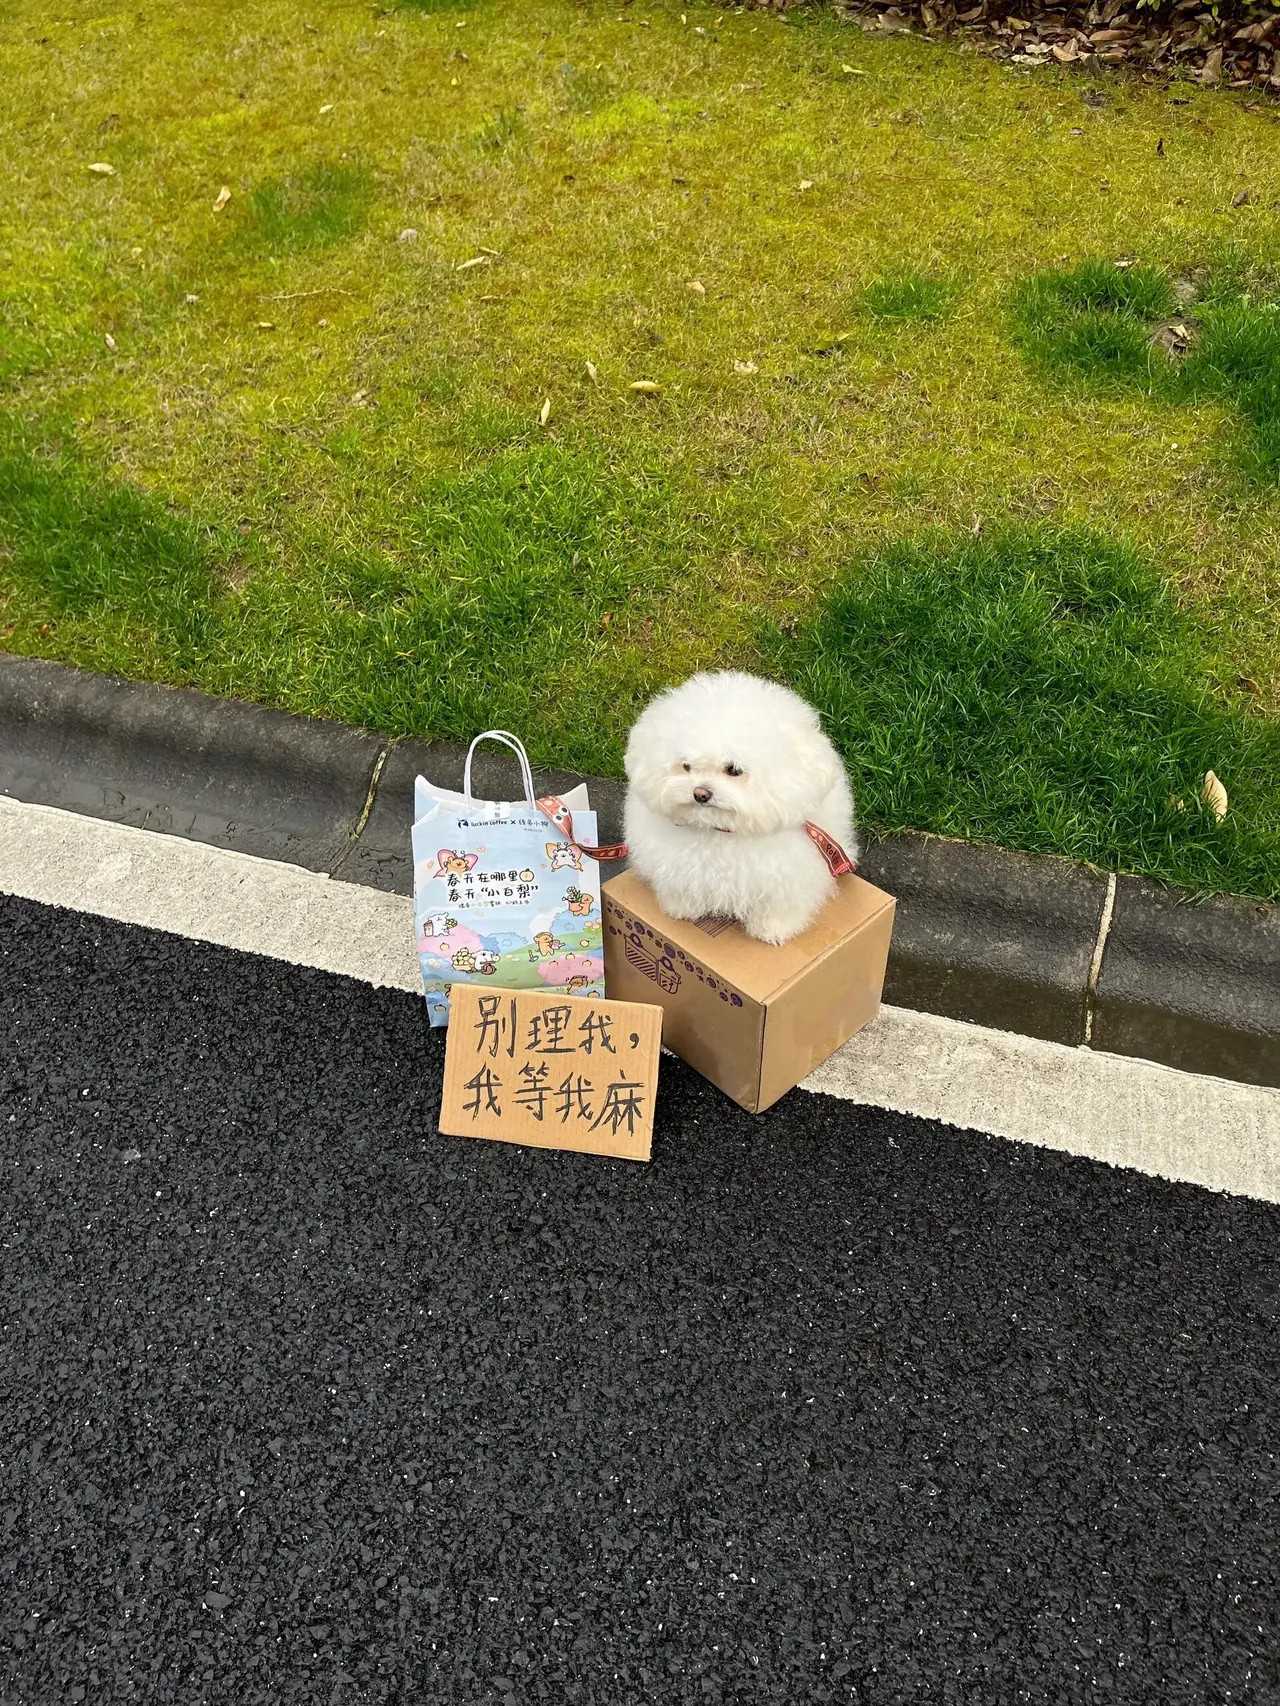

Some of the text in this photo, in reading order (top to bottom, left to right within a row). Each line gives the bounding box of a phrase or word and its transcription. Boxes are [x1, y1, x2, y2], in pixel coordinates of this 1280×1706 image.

[489, 819, 507, 827] coffee
[462, 1061, 646, 1137] 我等我麻
